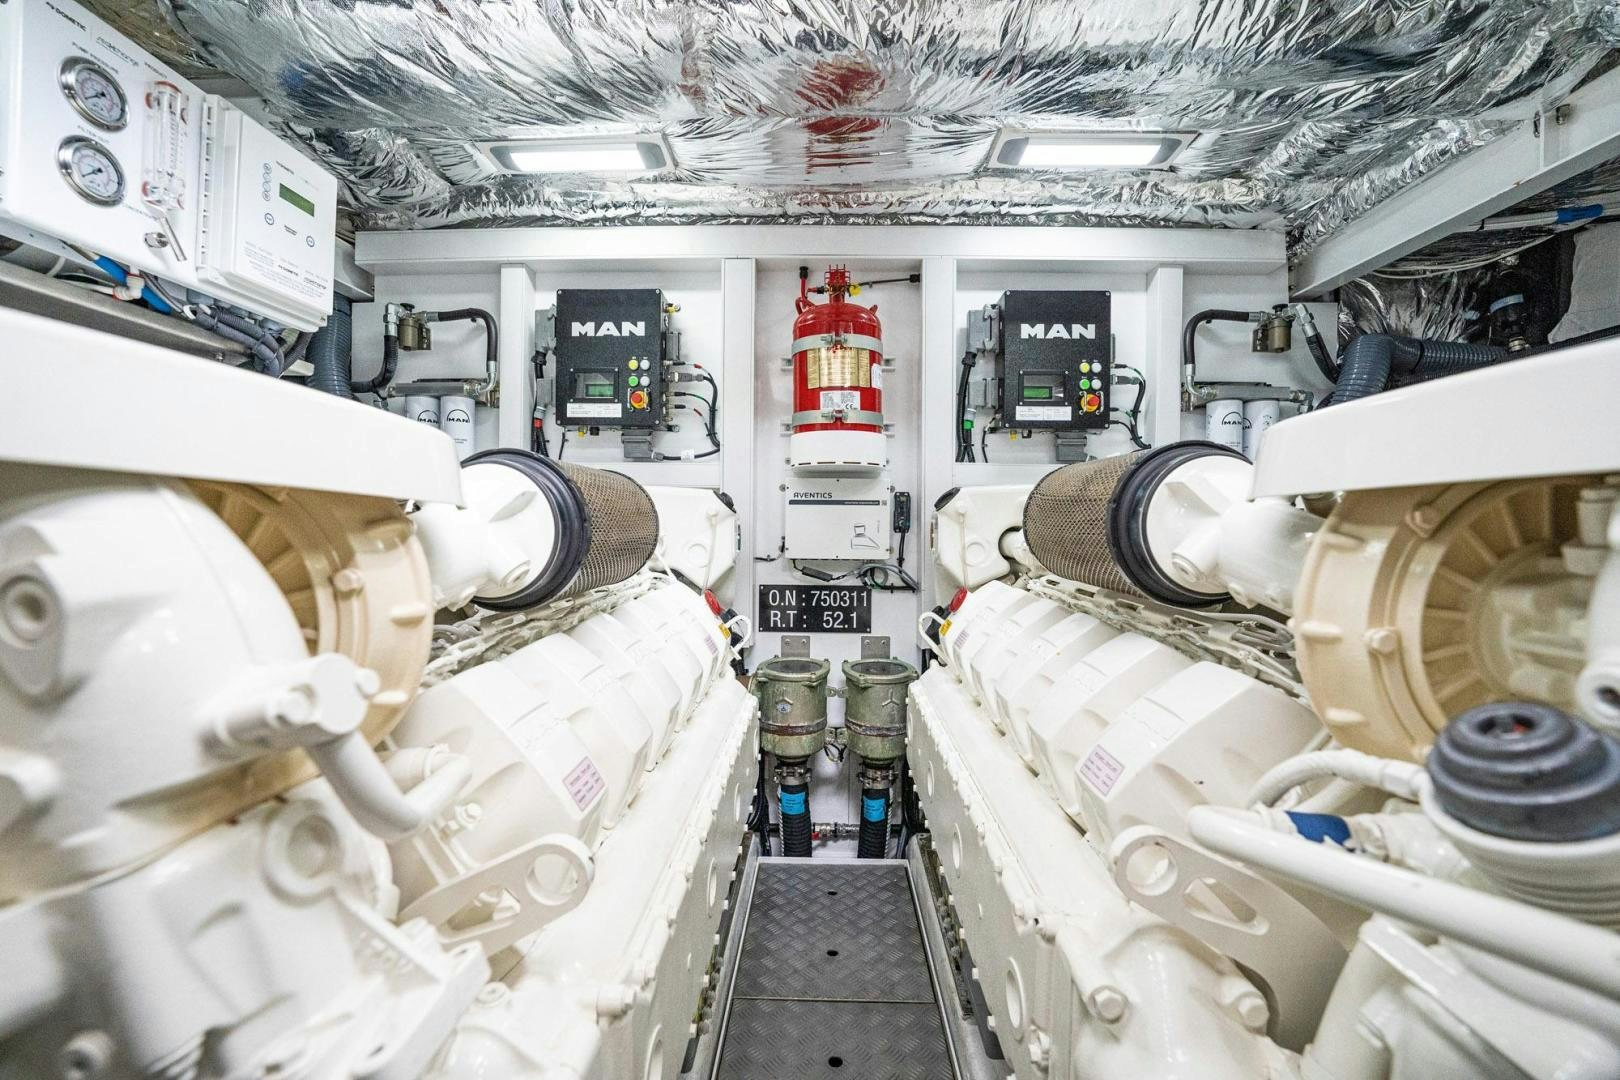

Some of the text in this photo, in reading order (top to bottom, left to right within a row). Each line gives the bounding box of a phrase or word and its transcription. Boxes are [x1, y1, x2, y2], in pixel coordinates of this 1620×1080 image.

[55, 7, 87, 32] DOMETIC
[571, 321, 646, 337] MAN
[1020, 323, 1096, 339] MAN
[811, 590, 868, 607] 750311
[823, 612, 858, 629] 52.1
